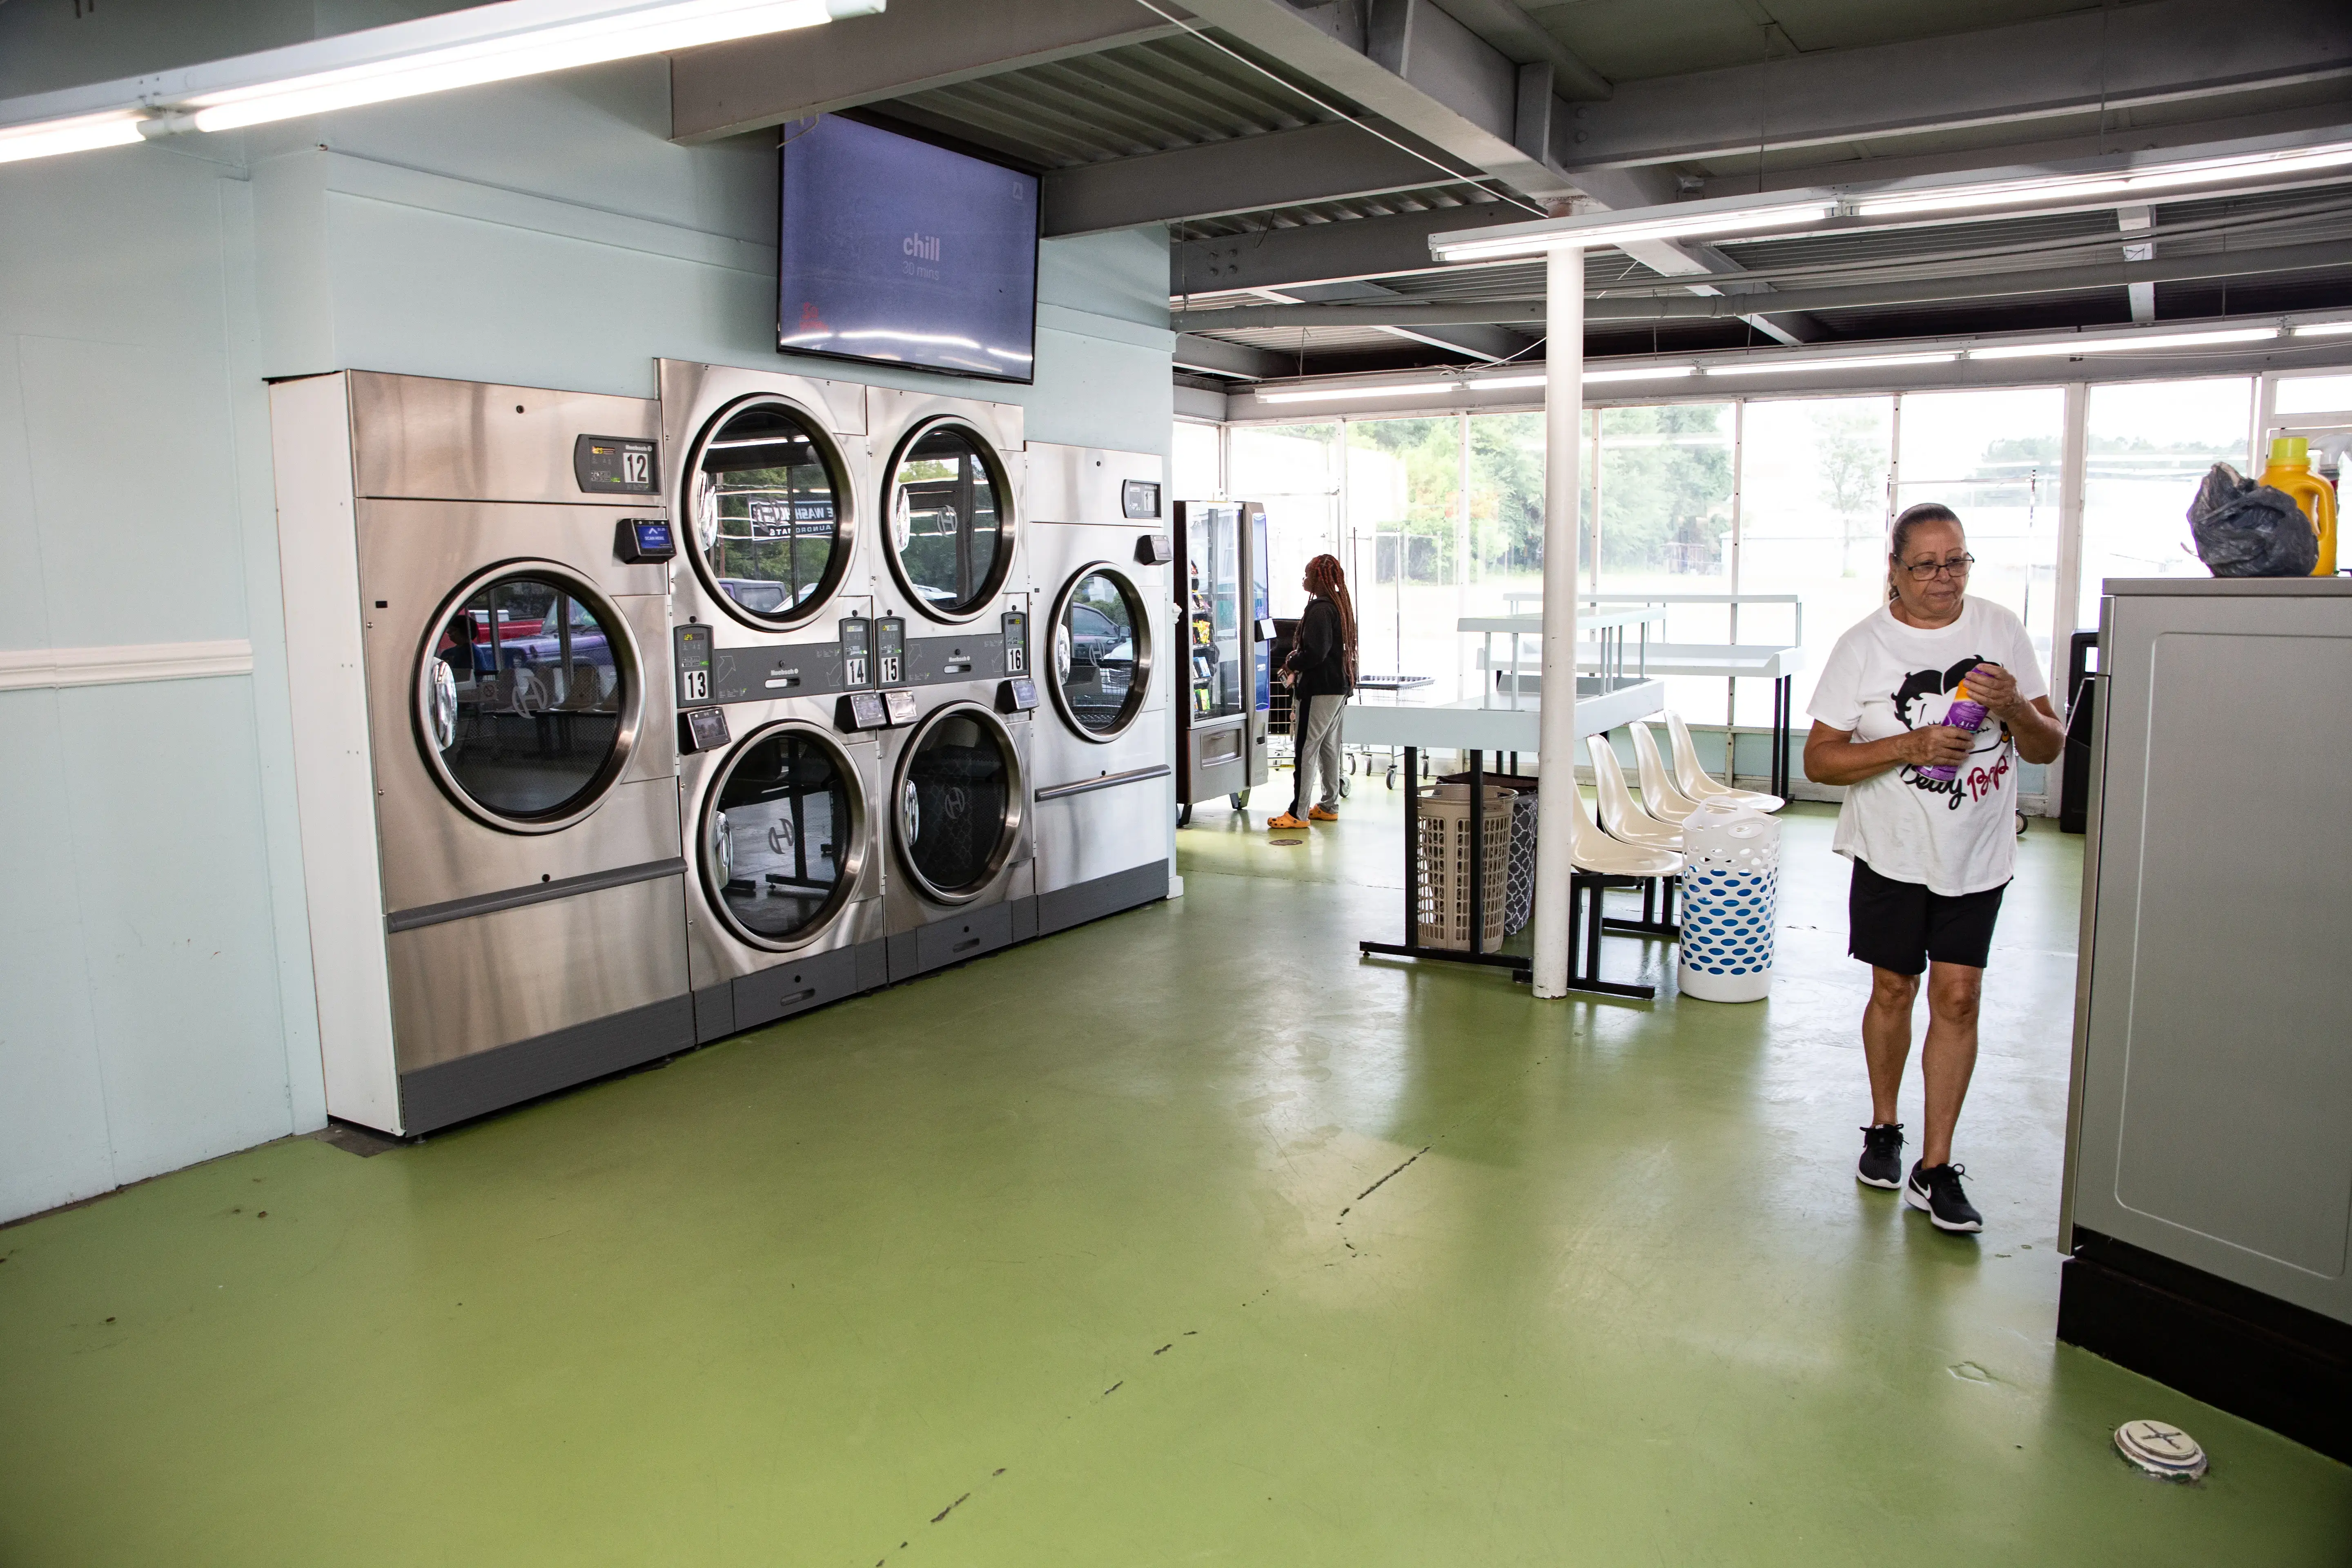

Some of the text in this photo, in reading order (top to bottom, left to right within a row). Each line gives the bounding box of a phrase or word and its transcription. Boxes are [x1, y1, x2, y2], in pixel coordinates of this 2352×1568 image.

[903, 232, 940, 261] chill
[902, 261, 940, 281] 30 mins
[627, 454, 647, 482] 12
[884, 658, 897, 681] 15
[1010, 649, 1021, 670] 16
[850, 660, 864, 683] 14
[688, 671, 706, 698] 13
